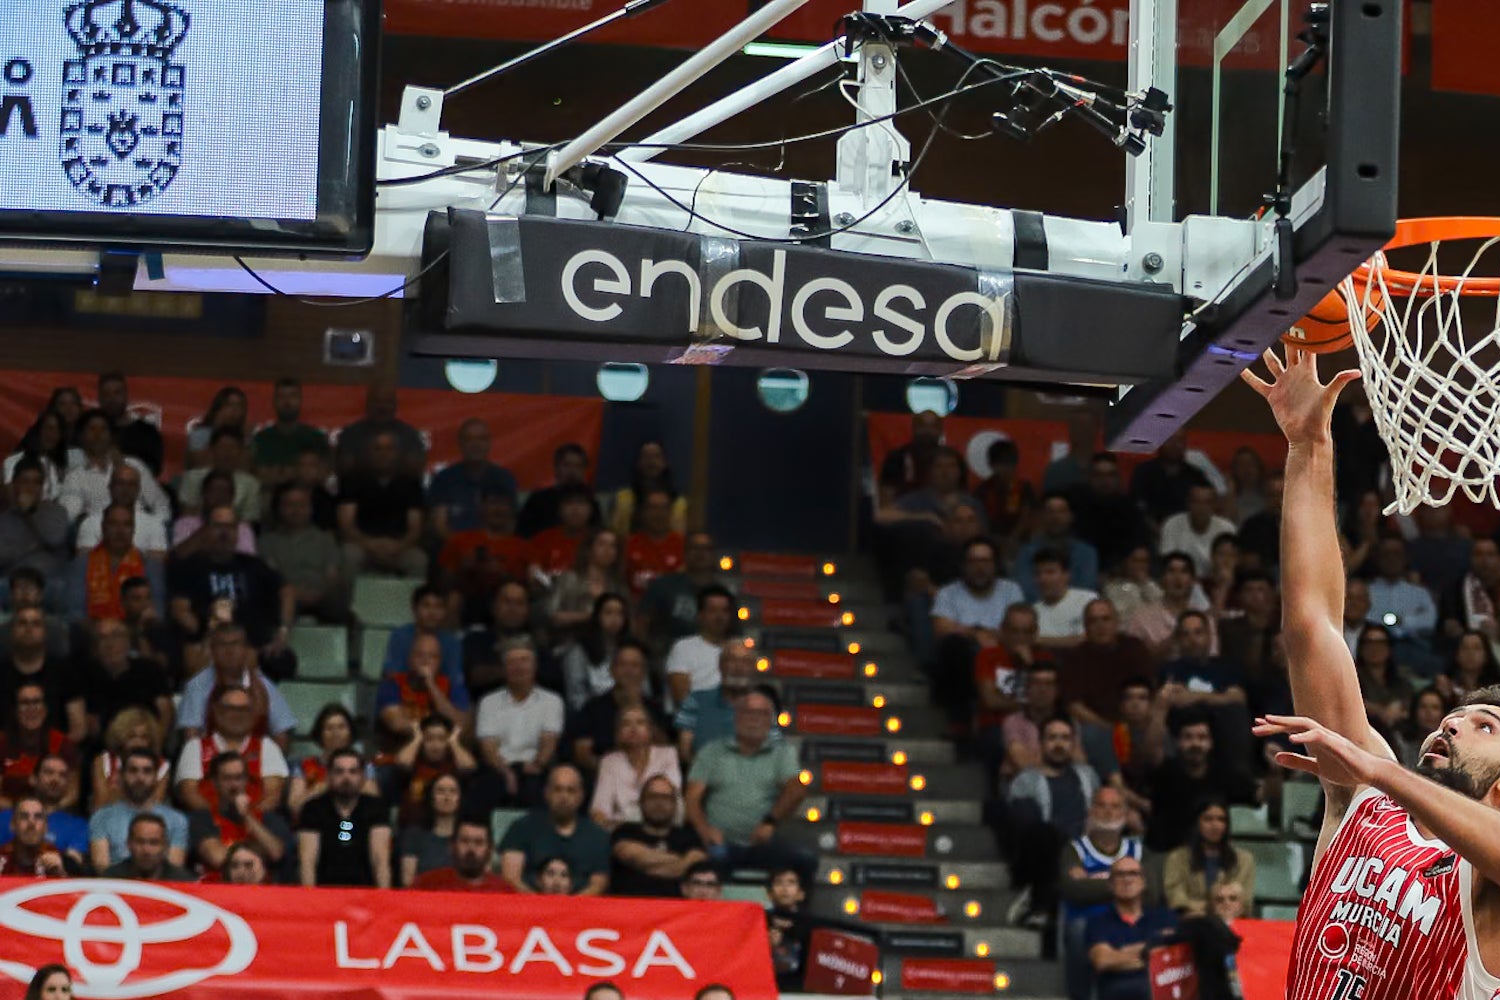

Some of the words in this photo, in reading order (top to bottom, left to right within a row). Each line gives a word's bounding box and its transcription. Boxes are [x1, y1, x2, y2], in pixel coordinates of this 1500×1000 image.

[561, 249, 1002, 362] endesa
[1330, 857, 1442, 937] UCAM
[1330, 900, 1403, 949] MURCIA
[334, 921, 696, 979] LABASA
